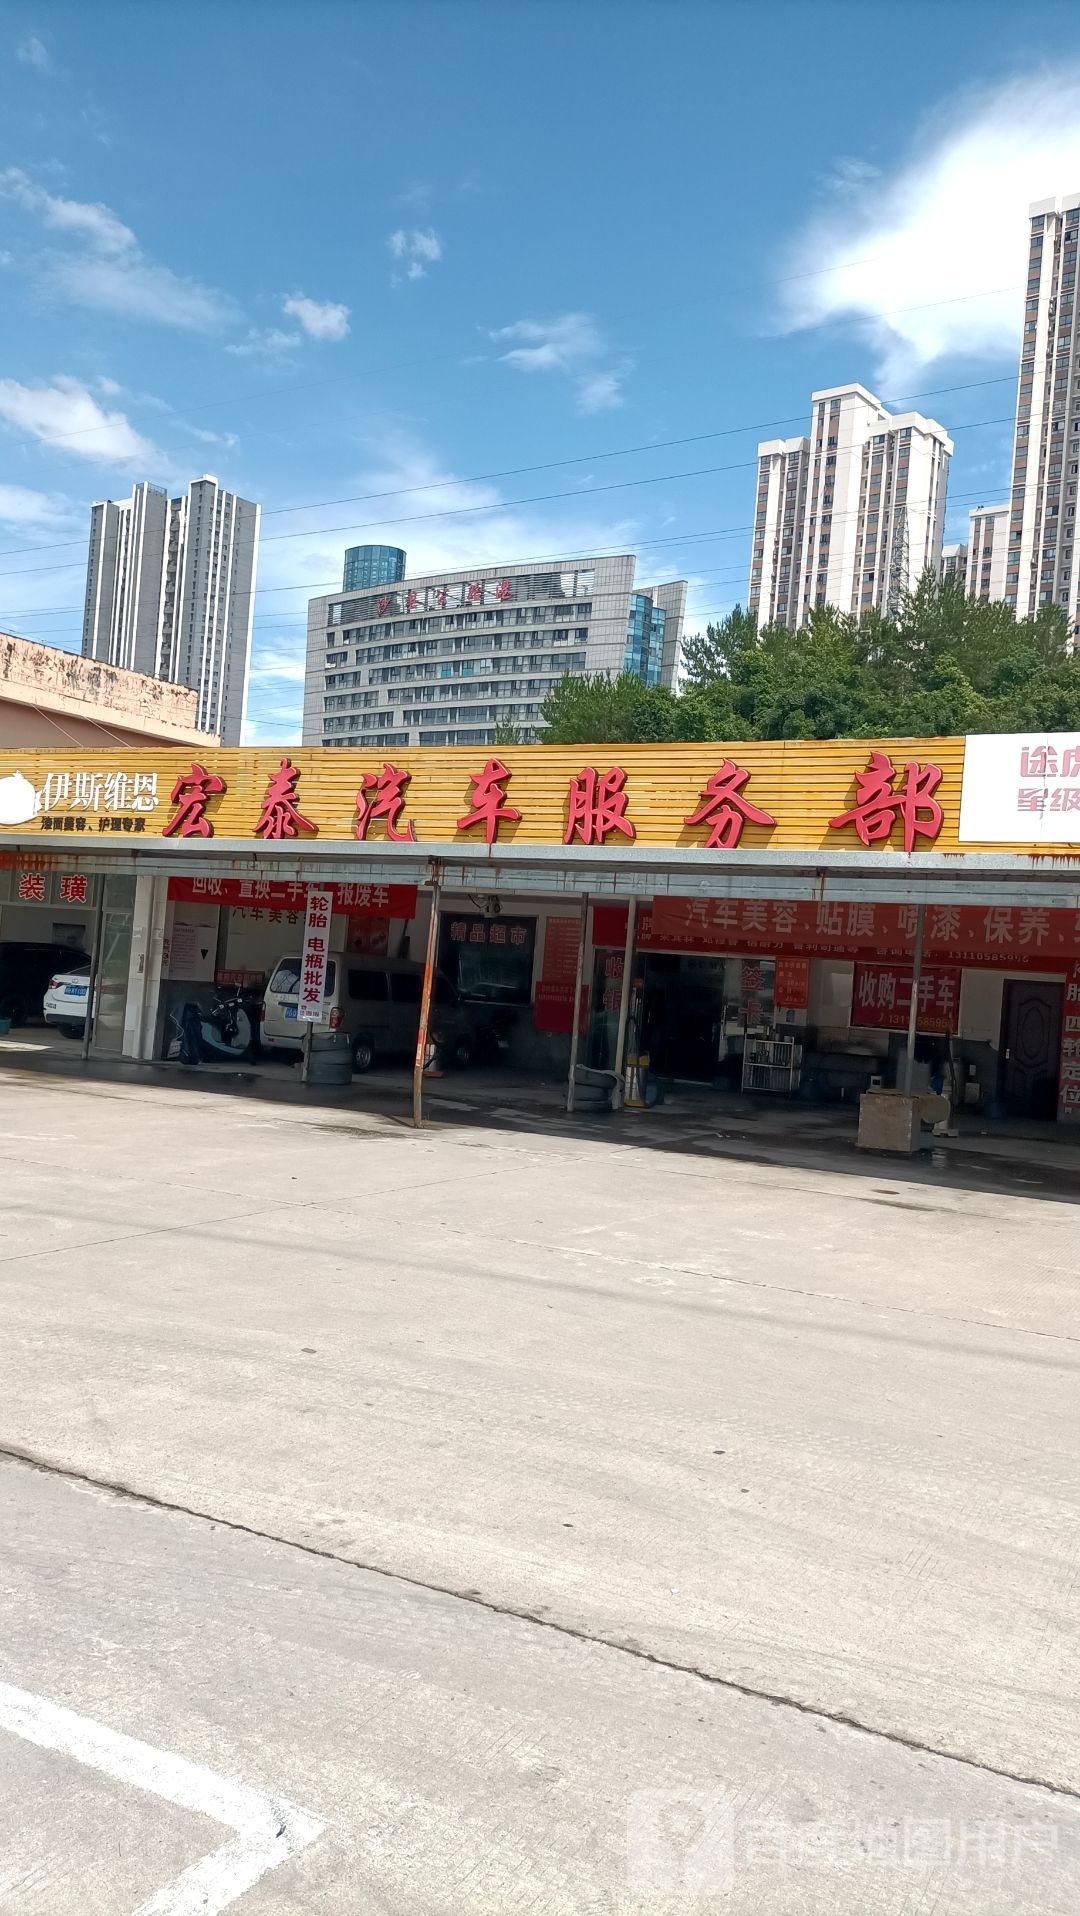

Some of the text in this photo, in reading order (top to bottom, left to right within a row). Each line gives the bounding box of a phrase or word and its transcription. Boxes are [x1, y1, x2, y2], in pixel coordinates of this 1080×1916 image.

[41, 771, 159, 812] 伊斯维恩
[162, 750, 944, 853] 宏泰汽车服务部
[1017, 788, 1080, 812] 星级
[19, 872, 87, 903] 装璜
[308, 896, 329, 928] 轮胎
[450, 921, 527, 945] 精品超市
[304, 937, 325, 1003] 电瓶批发
[858, 970, 956, 1015] 收购二手车
